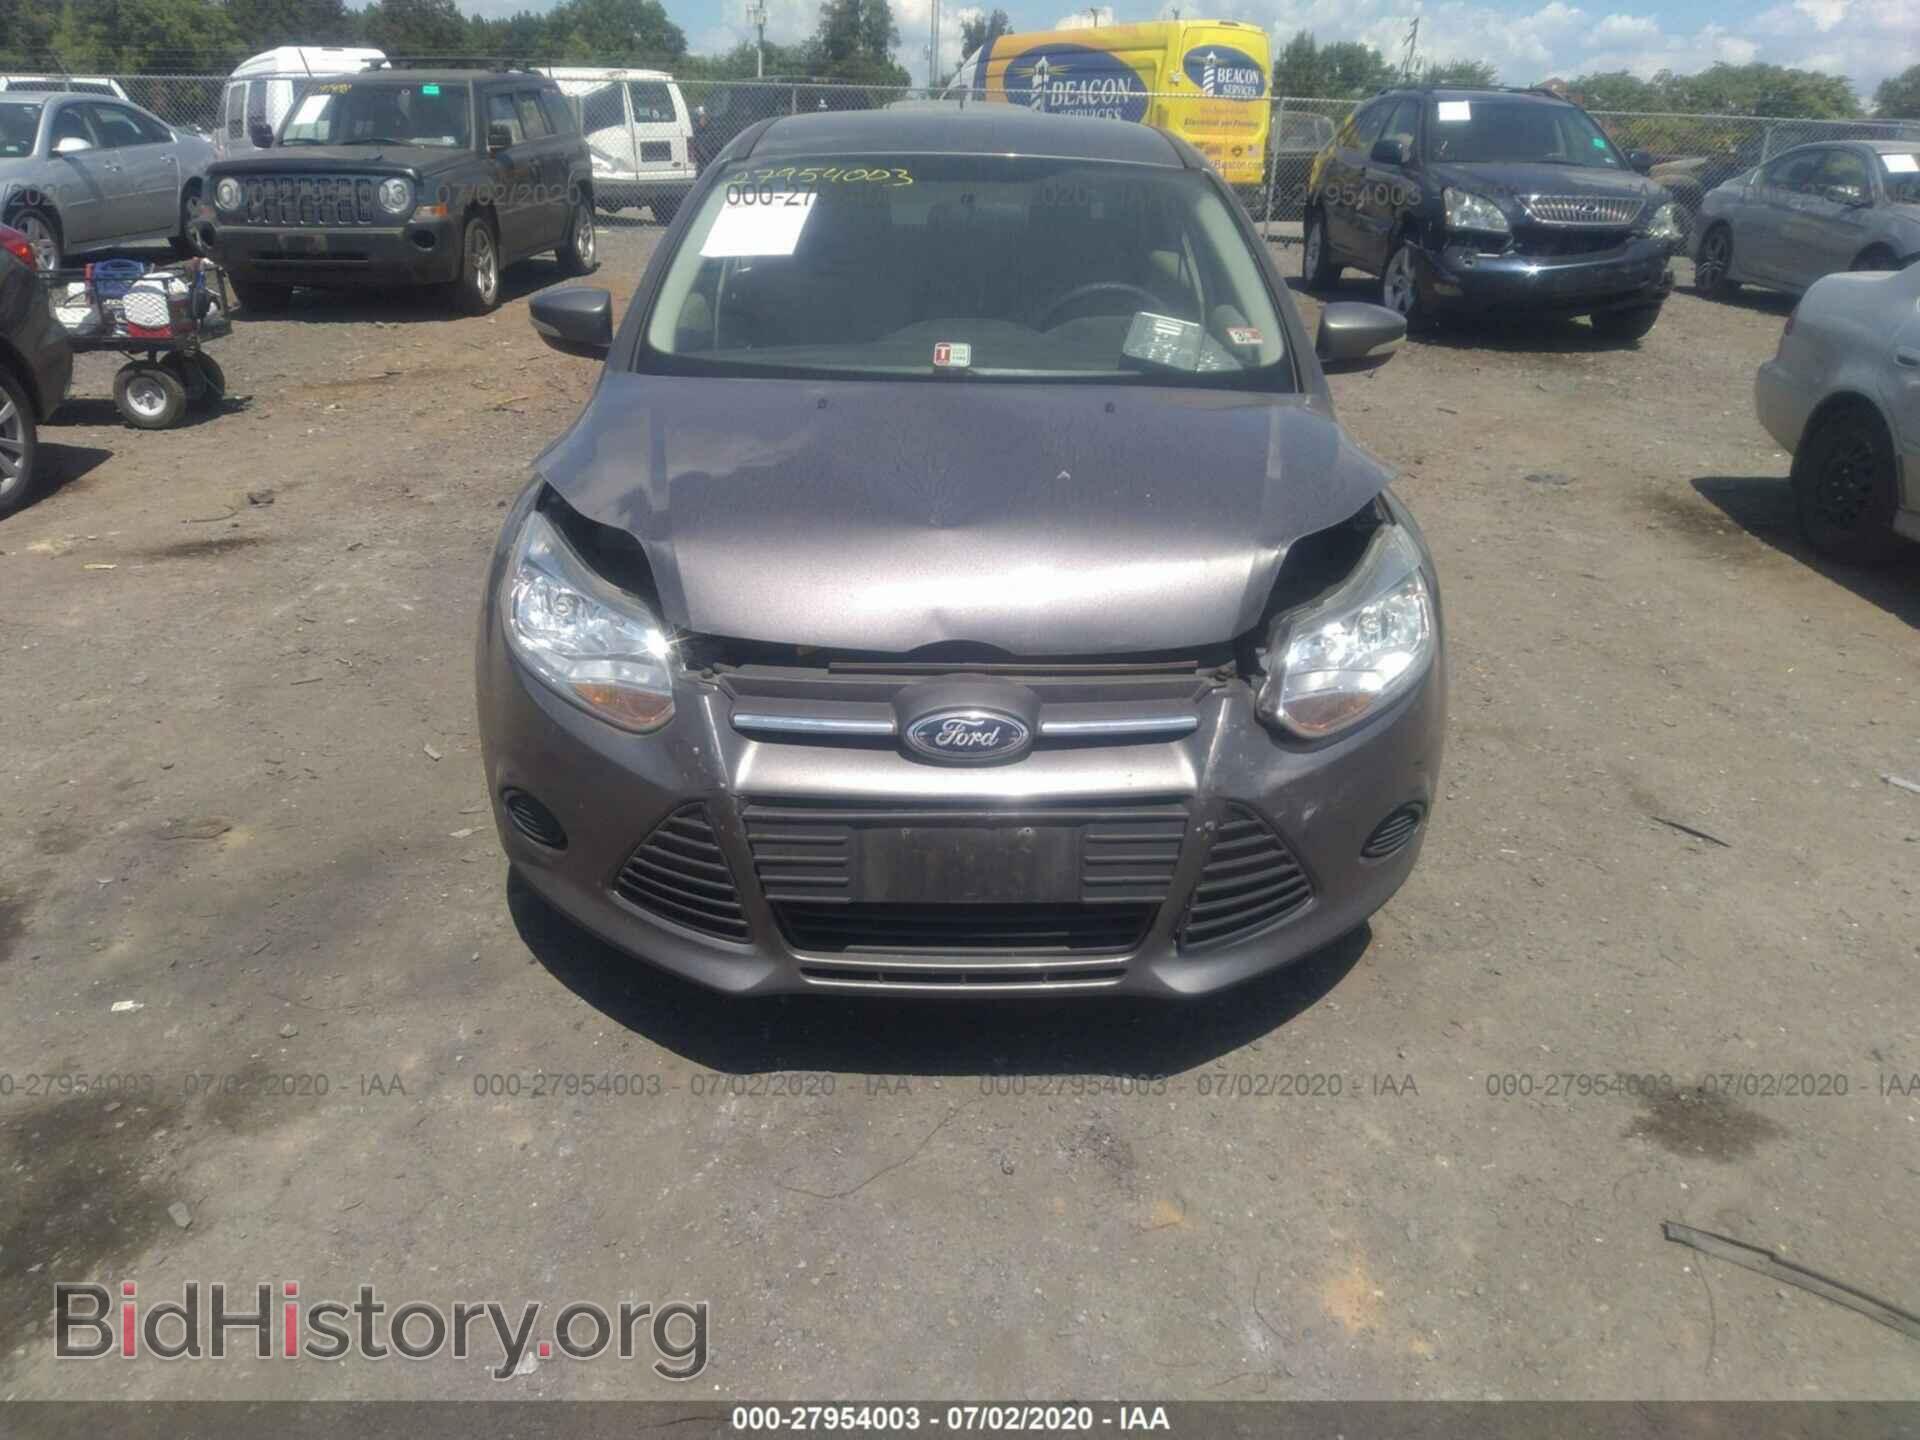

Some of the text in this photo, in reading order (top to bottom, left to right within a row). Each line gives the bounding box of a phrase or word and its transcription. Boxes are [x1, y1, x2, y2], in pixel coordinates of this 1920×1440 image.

[1217, 67, 1259, 85] BEACON
[1050, 77, 1131, 106] BEACON
[1223, 83, 1256, 97] SERVICES
[730, 167, 914, 187] 27954003
[936, 719, 1001, 747] Ford
